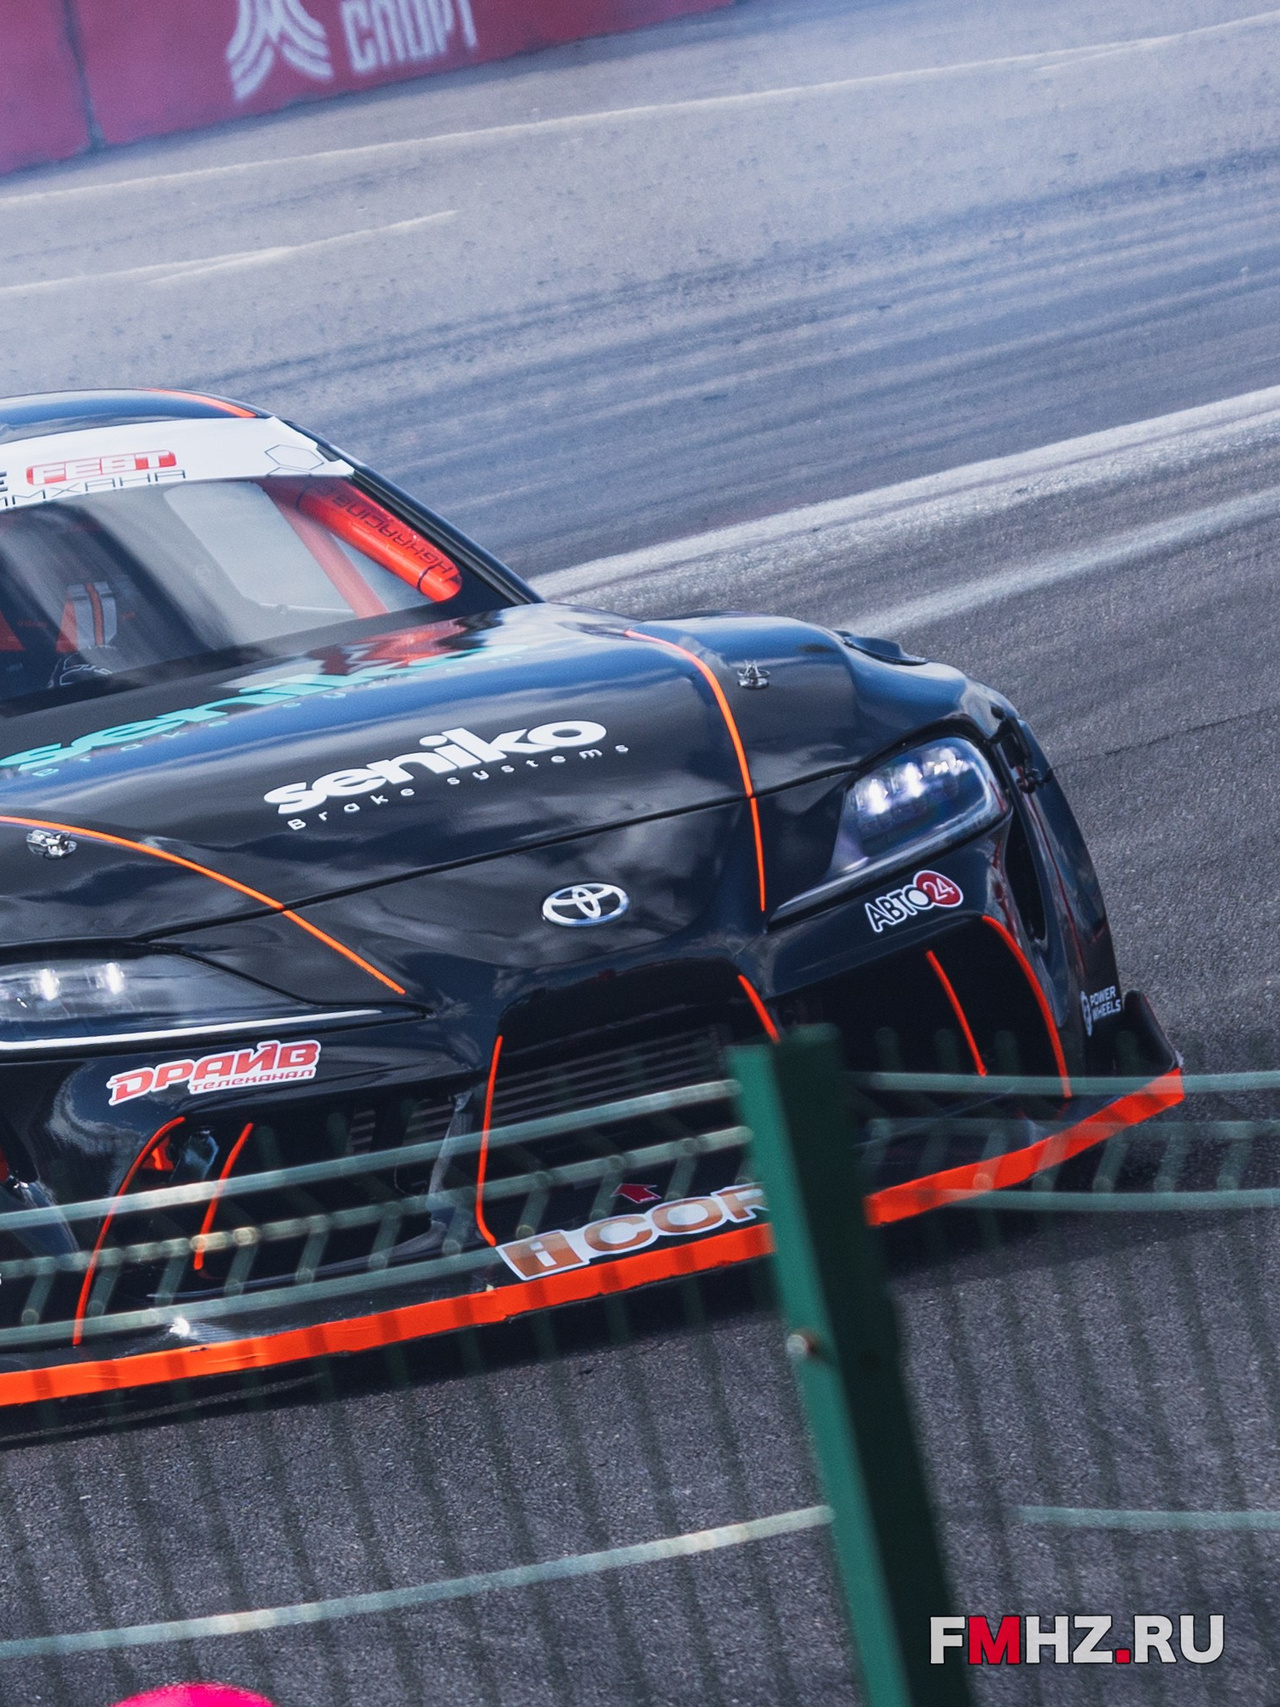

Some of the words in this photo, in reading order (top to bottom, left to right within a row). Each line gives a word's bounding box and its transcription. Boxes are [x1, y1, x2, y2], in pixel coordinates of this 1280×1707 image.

[263, 720, 606, 814] seniko
[287, 788, 415, 831] Brake
[447, 744, 629, 785] systems
[110, 1041, 320, 1102] ДРАЙВ
